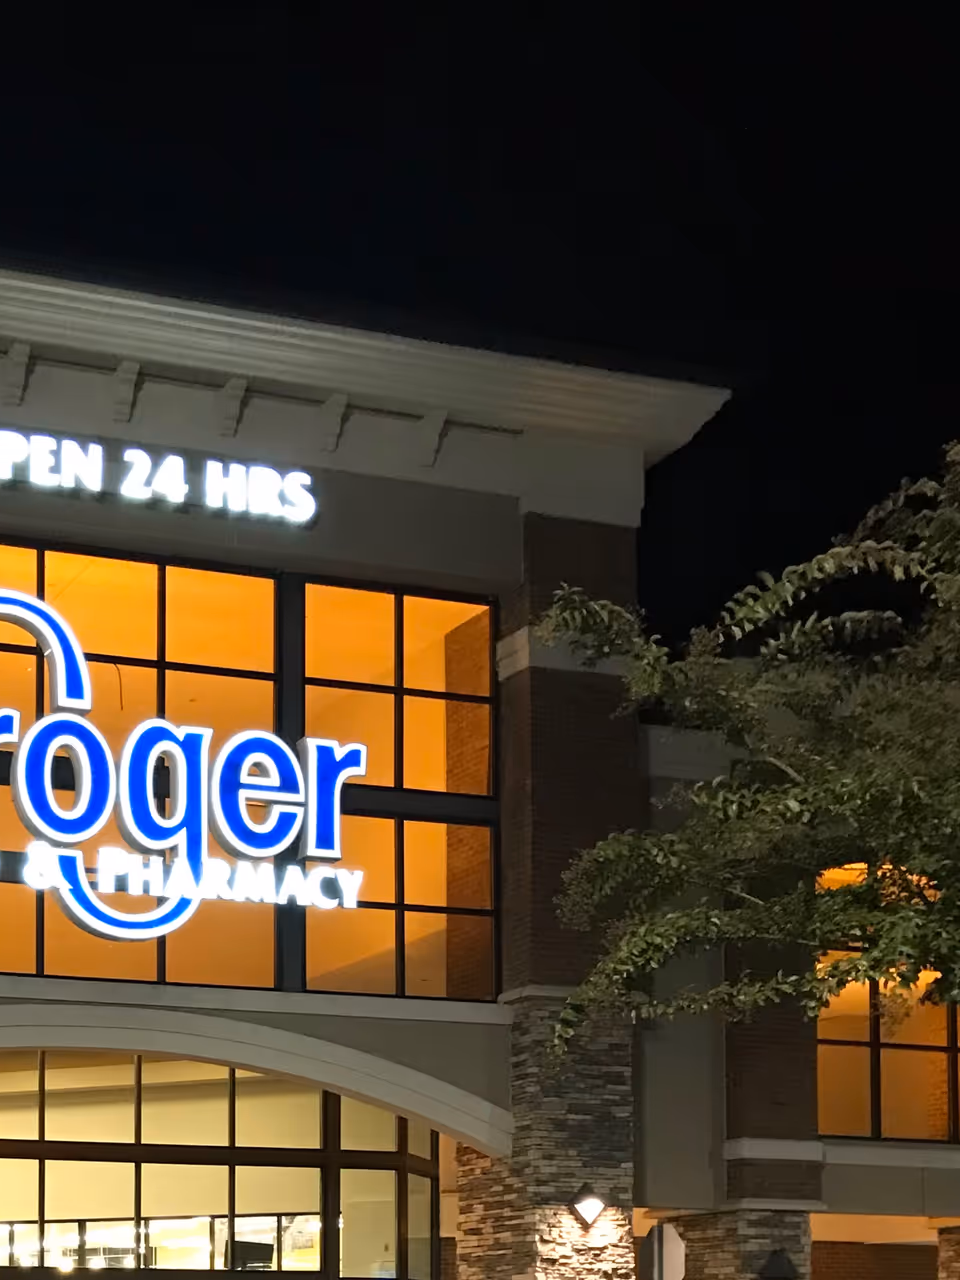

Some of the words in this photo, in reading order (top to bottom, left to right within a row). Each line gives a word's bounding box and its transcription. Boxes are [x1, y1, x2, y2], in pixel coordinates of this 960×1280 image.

[119, 448, 189, 504] 24
[205, 458, 318, 523] HRS
[22, 840, 74, 890] &
[98, 847, 366, 909] PHARMACY
